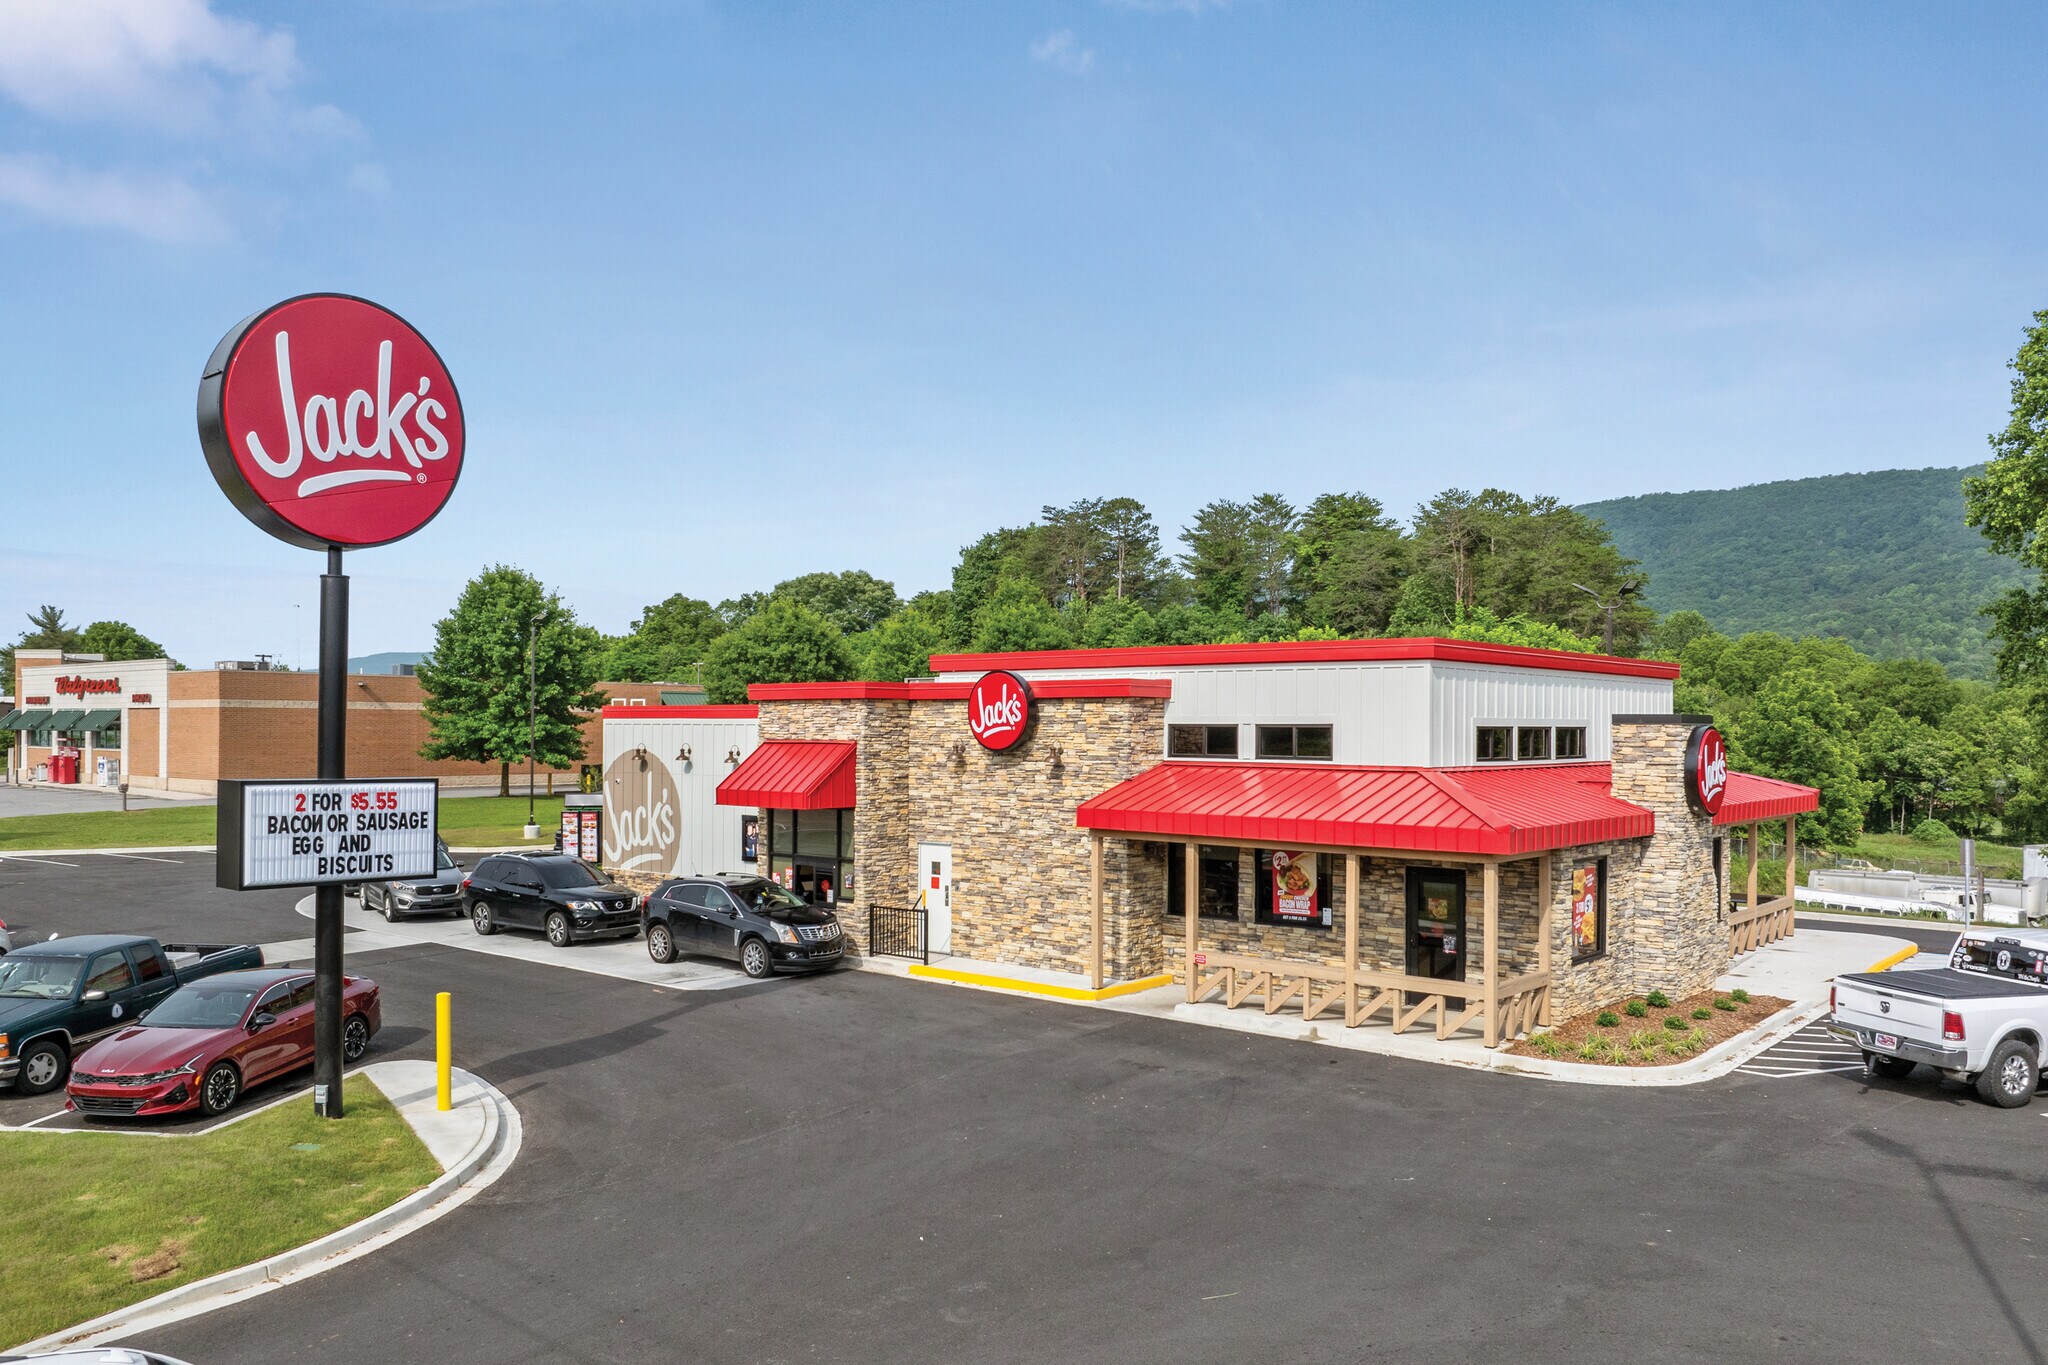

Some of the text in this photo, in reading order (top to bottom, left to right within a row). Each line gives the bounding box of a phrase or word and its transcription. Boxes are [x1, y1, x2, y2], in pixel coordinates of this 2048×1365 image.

[246, 330, 449, 479] Jack's
[55, 675, 121, 701] Walgreens
[971, 683, 1022, 734] Jack's
[1701, 741, 1727, 797] Jack's
[295, 792, 398, 812] 2 FOR $5.55
[328, 814, 348, 832] OR
[357, 811, 428, 831] SAUSAGE
[603, 770, 675, 862] Jack's
[292, 834, 371, 855] EGG AND
[318, 854, 393, 876] BISCUITS
[1279, 899, 1310, 910] BACON WRAP
